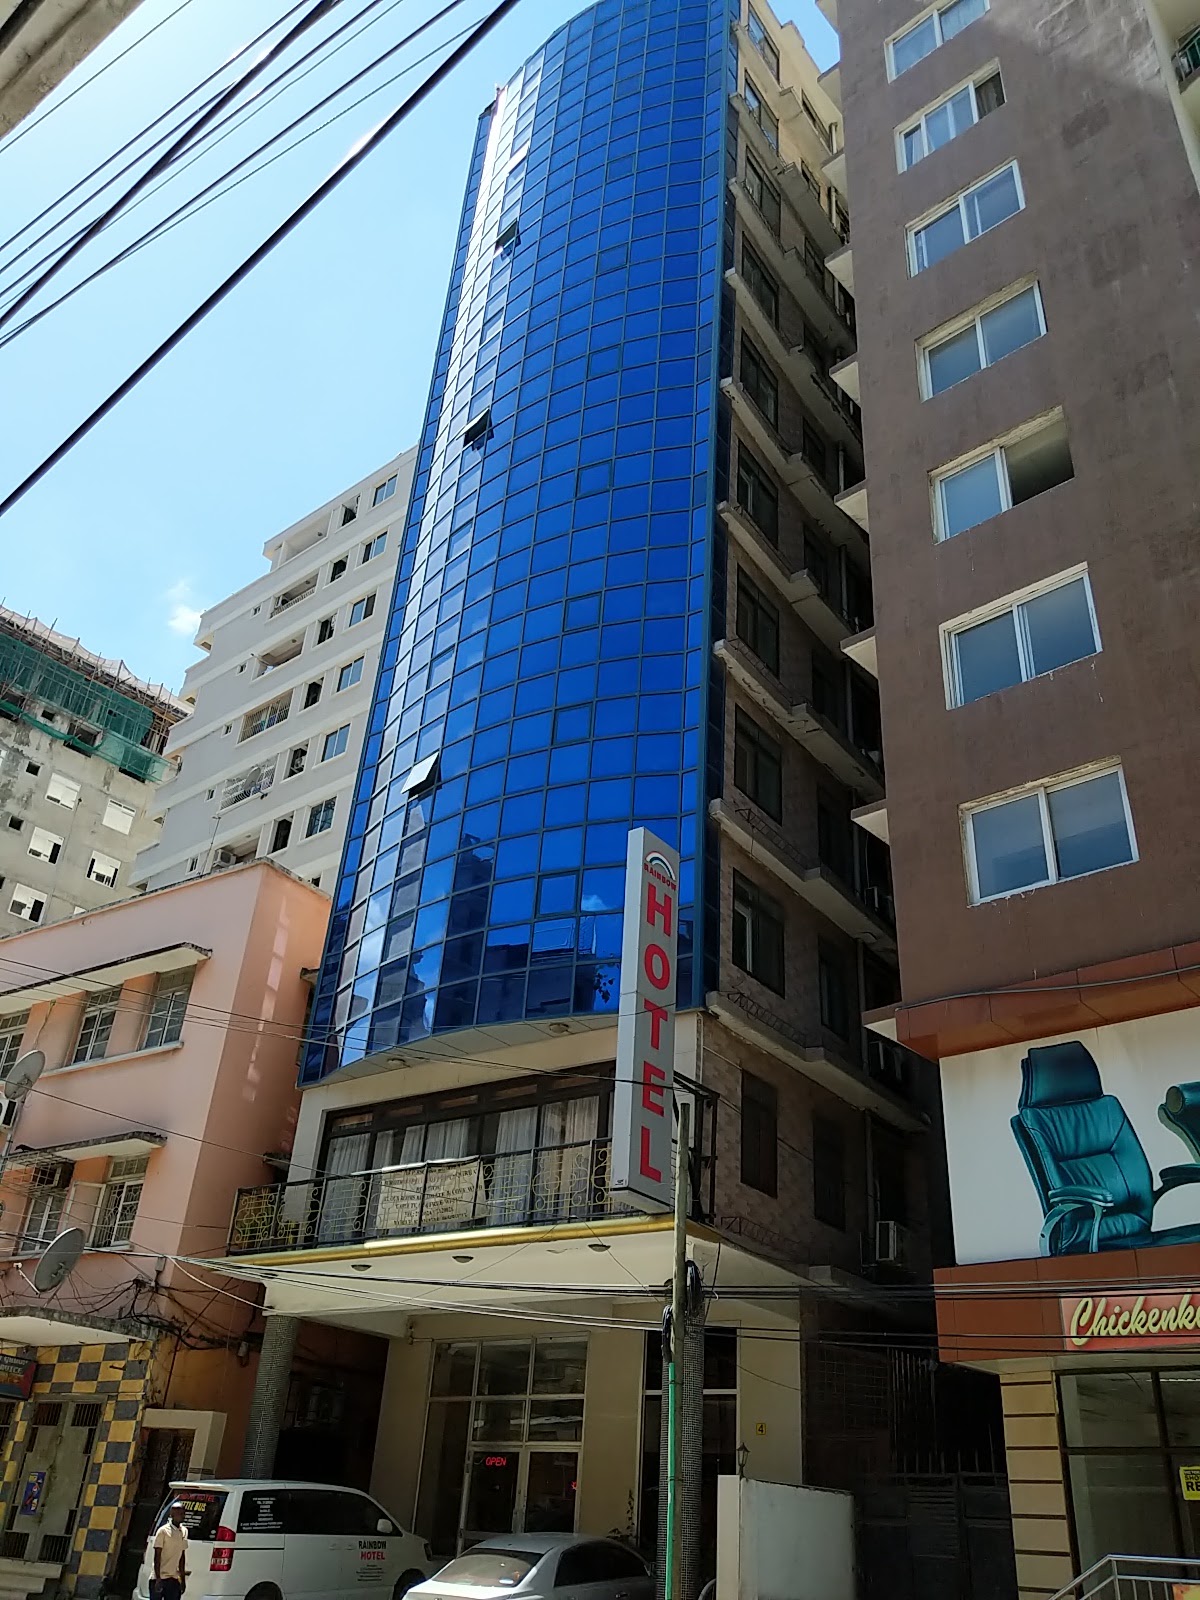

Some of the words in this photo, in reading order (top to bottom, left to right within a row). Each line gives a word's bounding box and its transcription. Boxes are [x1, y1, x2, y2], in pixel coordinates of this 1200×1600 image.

[643, 862, 677, 891] RAINBOW
[639, 880, 673, 1184] HOTEL
[757, 1424, 765, 1434] 4
[485, 1456, 507, 1467] OPEN
[194, 1501, 207, 1512] BUS
[358, 1540, 387, 1550] RAINBOW
[360, 1551, 386, 1561] HOTEL
